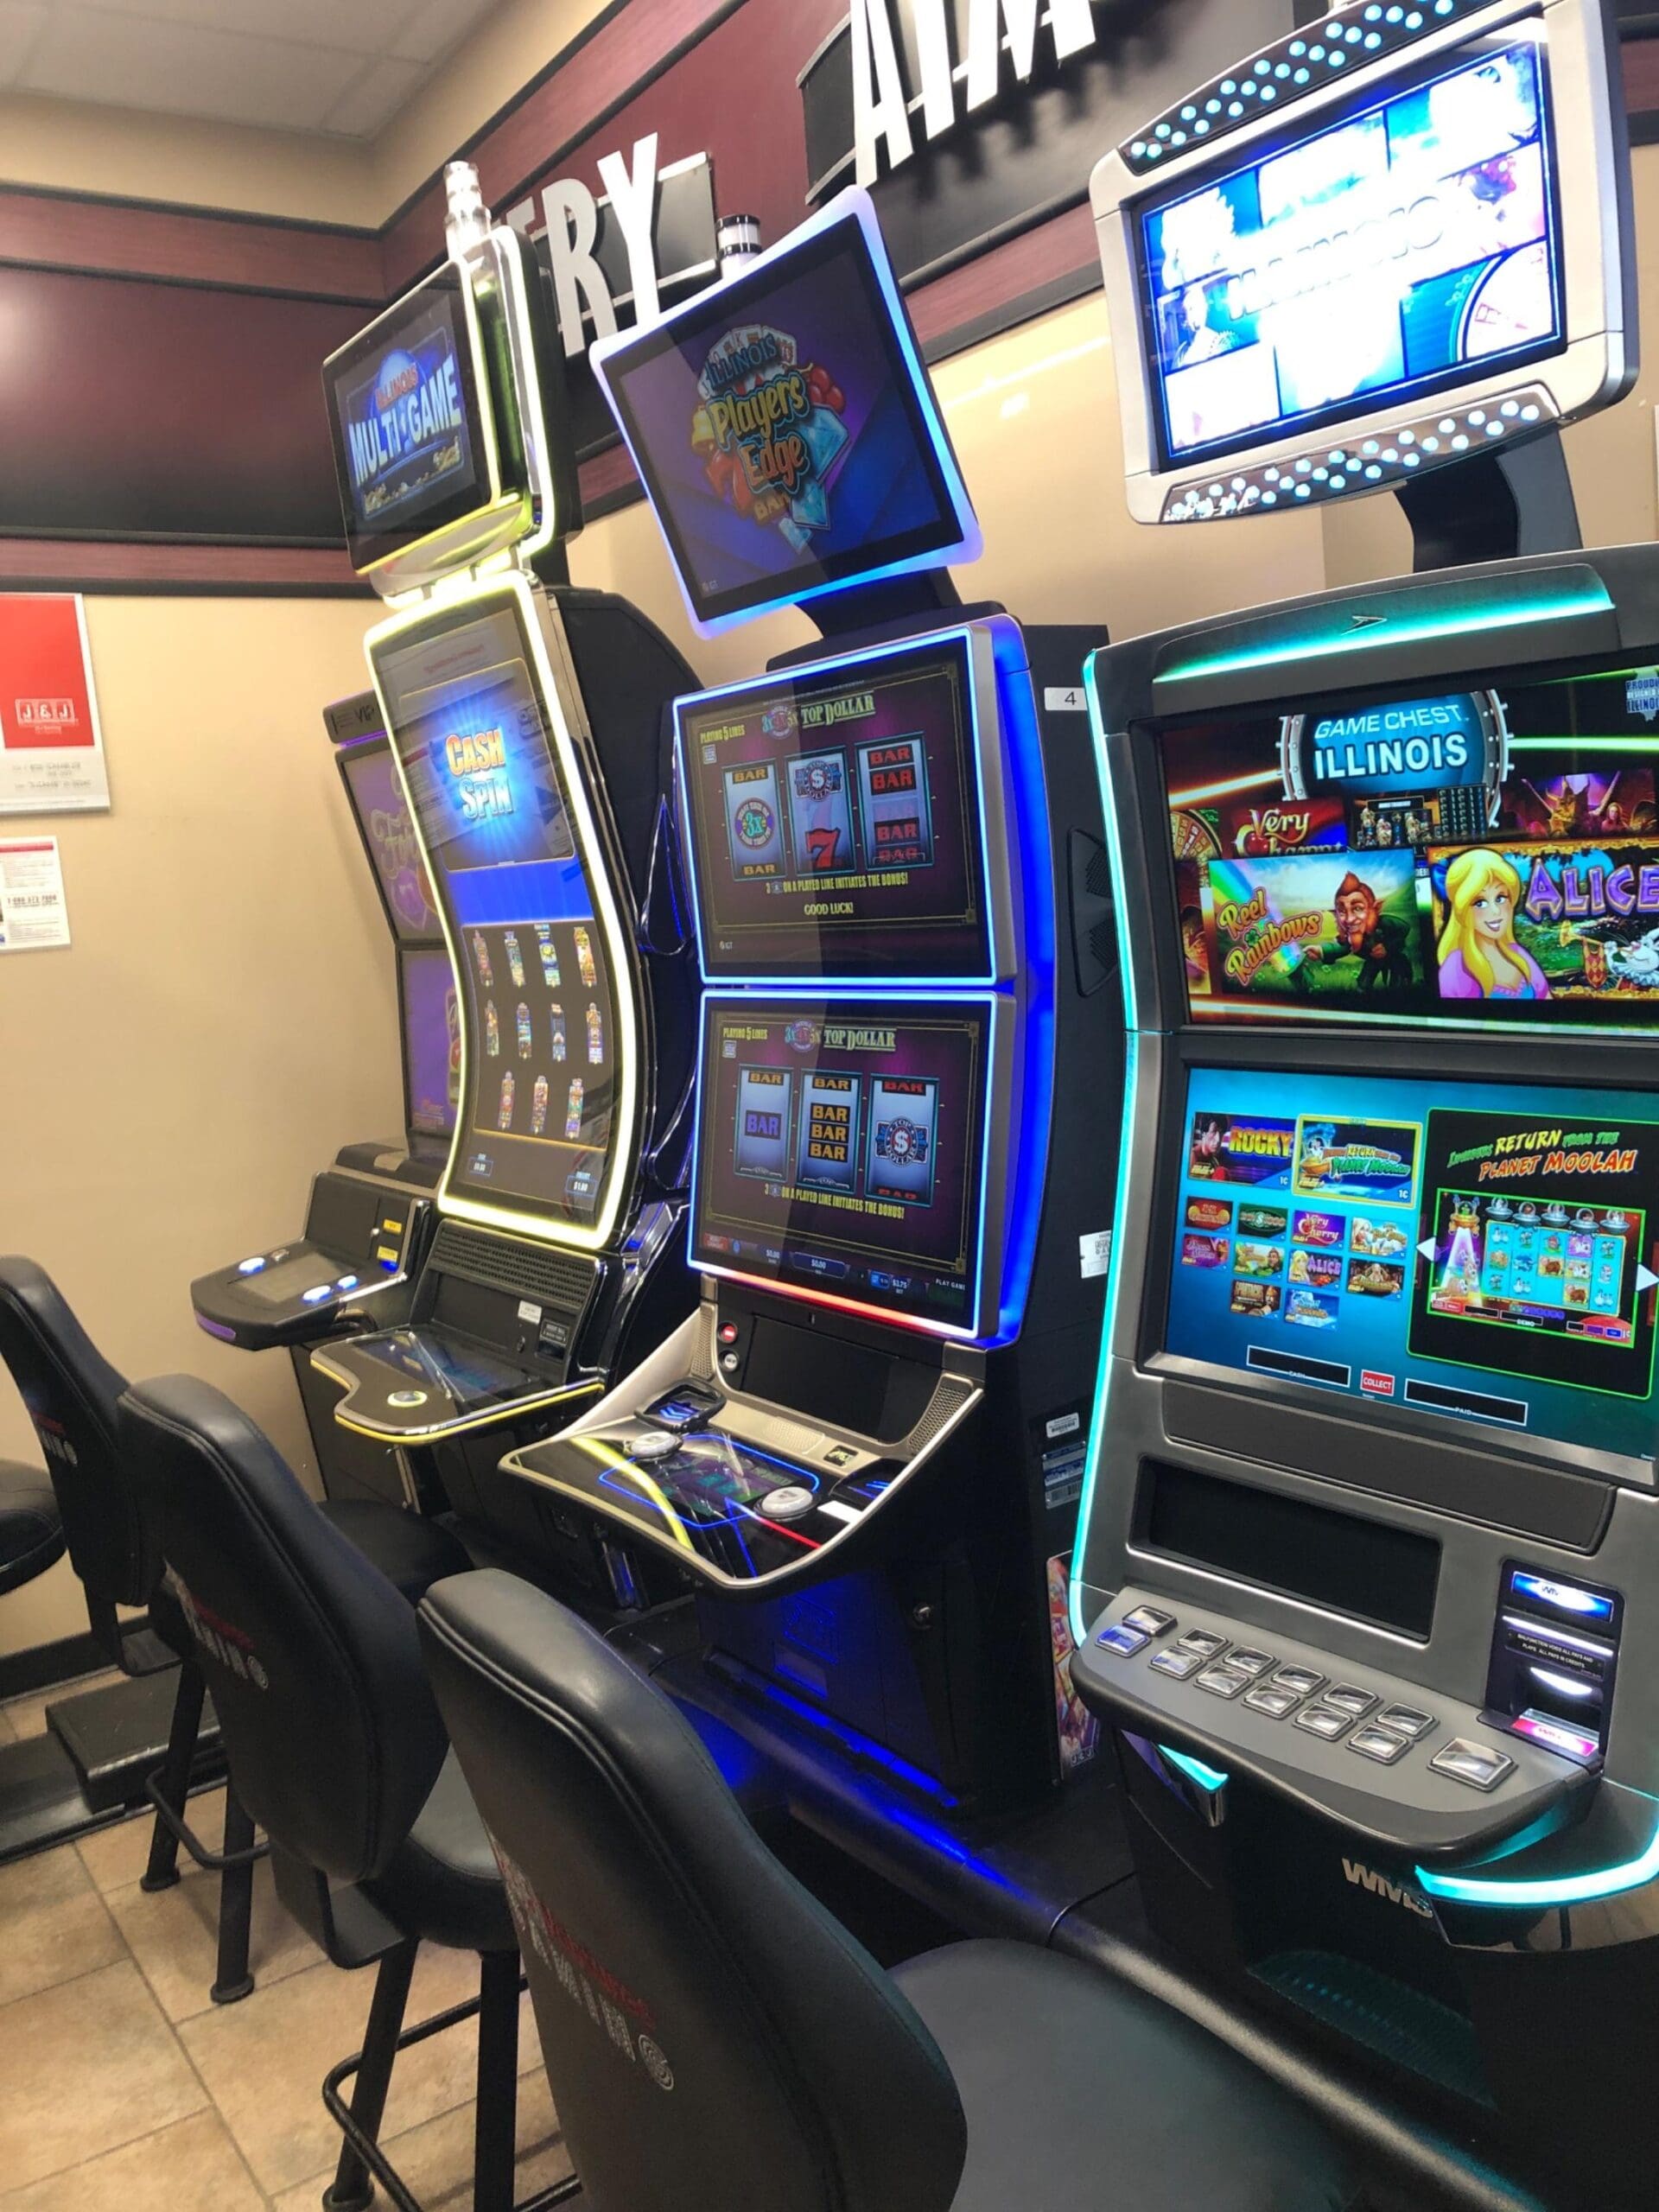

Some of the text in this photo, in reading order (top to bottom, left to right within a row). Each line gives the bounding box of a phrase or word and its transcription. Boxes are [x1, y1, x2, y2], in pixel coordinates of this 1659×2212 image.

[704, 334, 778, 388] ILLINOIS
[375, 362, 419, 410] ILLINOIS
[407, 354, 462, 443] GAME
[708, 376, 805, 445] Players
[740, 435, 805, 487] Edge
[1064, 691, 1077, 706] 4
[355, 703, 376, 723] VIP
[801, 694, 874, 726] TOP DOLLAR
[722, 725, 729, 741] 5
[1313, 704, 1463, 740] GAME CHEST
[445, 728, 505, 777] CASH
[870, 747, 912, 764] BAR
[1313, 733, 1468, 781] ILLINOIS
[734, 768, 766, 783] BAR
[873, 769, 913, 790] BAR
[459, 777, 514, 820] SPIN
[876, 823, 918, 842] BAR
[1249, 809, 1311, 841] Very
[804, 828, 840, 868] 7
[743, 864, 776, 875] BAR
[820, 877, 835, 890] LINE
[835, 874, 867, 889] INITIATES
[866, 874, 881, 887] THE
[880, 871, 909, 887] BONUS!
[1526, 859, 1659, 921] ALICE
[804, 901, 855, 916] GOOD LUCK!
[1217, 888, 1268, 935] Reel
[1224, 912, 1324, 986] Rainbows
[746, 1026, 752, 1041] 5
[824, 1028, 896, 1052] TOP DOLLAR
[749, 1071, 783, 1084] BAR
[814, 1078, 849, 1090] BAR
[812, 1104, 849, 1122] BAR
[746, 1113, 779, 1136] BAR
[810, 1123, 848, 1141] BAR
[810, 1142, 846, 1161] BAR
[1229, 1126, 1293, 1158] ROCKY
[1494, 1128, 1562, 1156] RETURN
[1477, 1154, 1542, 1183] PLANET
[1541, 1149, 1638, 1176] MOOLAH
[864, 1199, 878, 1215] THE
[877, 1202, 906, 1220] BONUS!
[1306, 1255, 1342, 1275] ALICE
[935, 1278, 950, 1287] PLAY
[1362, 1376, 1392, 1390] COLLECT
